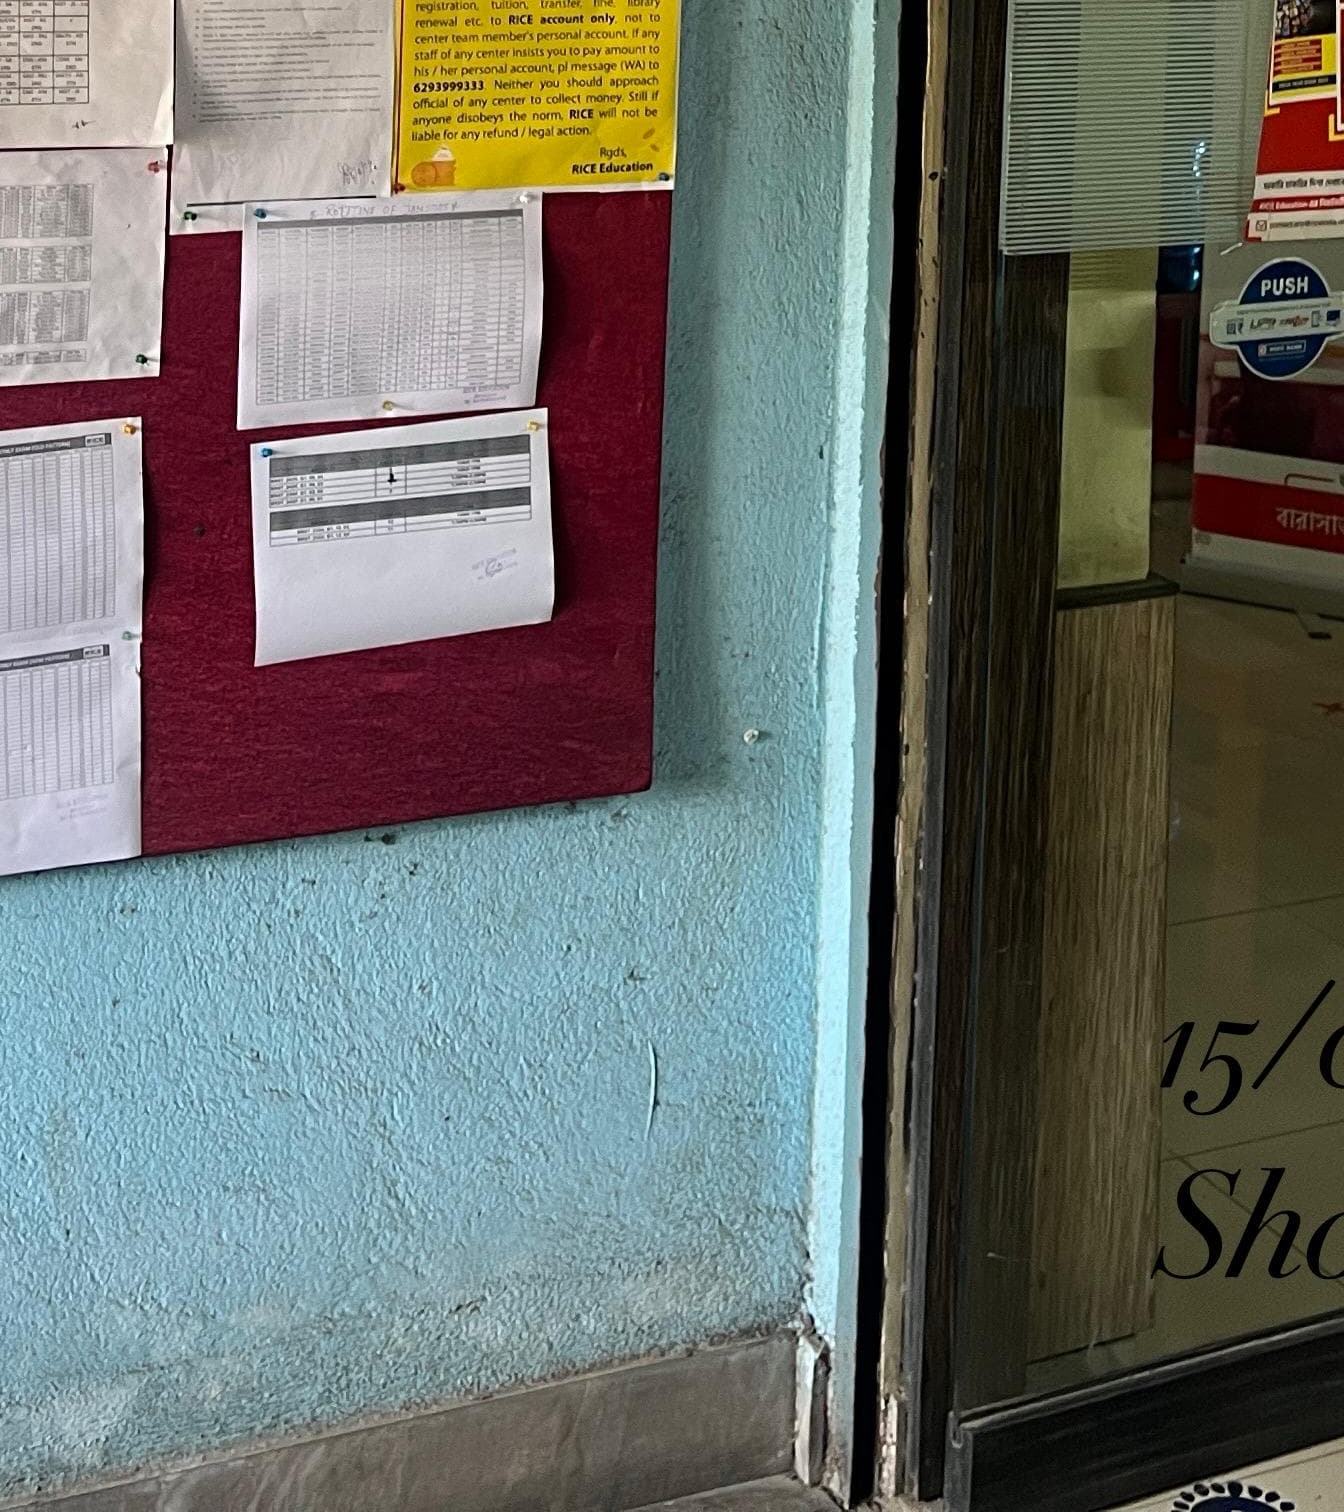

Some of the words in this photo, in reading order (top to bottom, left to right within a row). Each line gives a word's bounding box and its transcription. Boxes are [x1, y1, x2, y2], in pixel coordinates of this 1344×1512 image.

[494, 80, 534, 90] Neither
[540, 80, 560, 90] you
[567, 76, 602, 87] should
[610, 75, 659, 88] approach
[412, 116, 452, 126] anyone
[457, 112, 504, 124] disobeys
[510, 112, 527, 121] the
[532, 112, 564, 121] norm,
[570, 109, 594, 119] RICE
[599, 107, 616, 118] will
[622, 108, 640, 118] not
[644, 106, 658, 116] be
[599, 147, 627, 160] Rgds,
[572, 164, 596, 174] RICE
[600, 161, 653, 174] Education
[1261, 276, 1308, 297] PUSH
